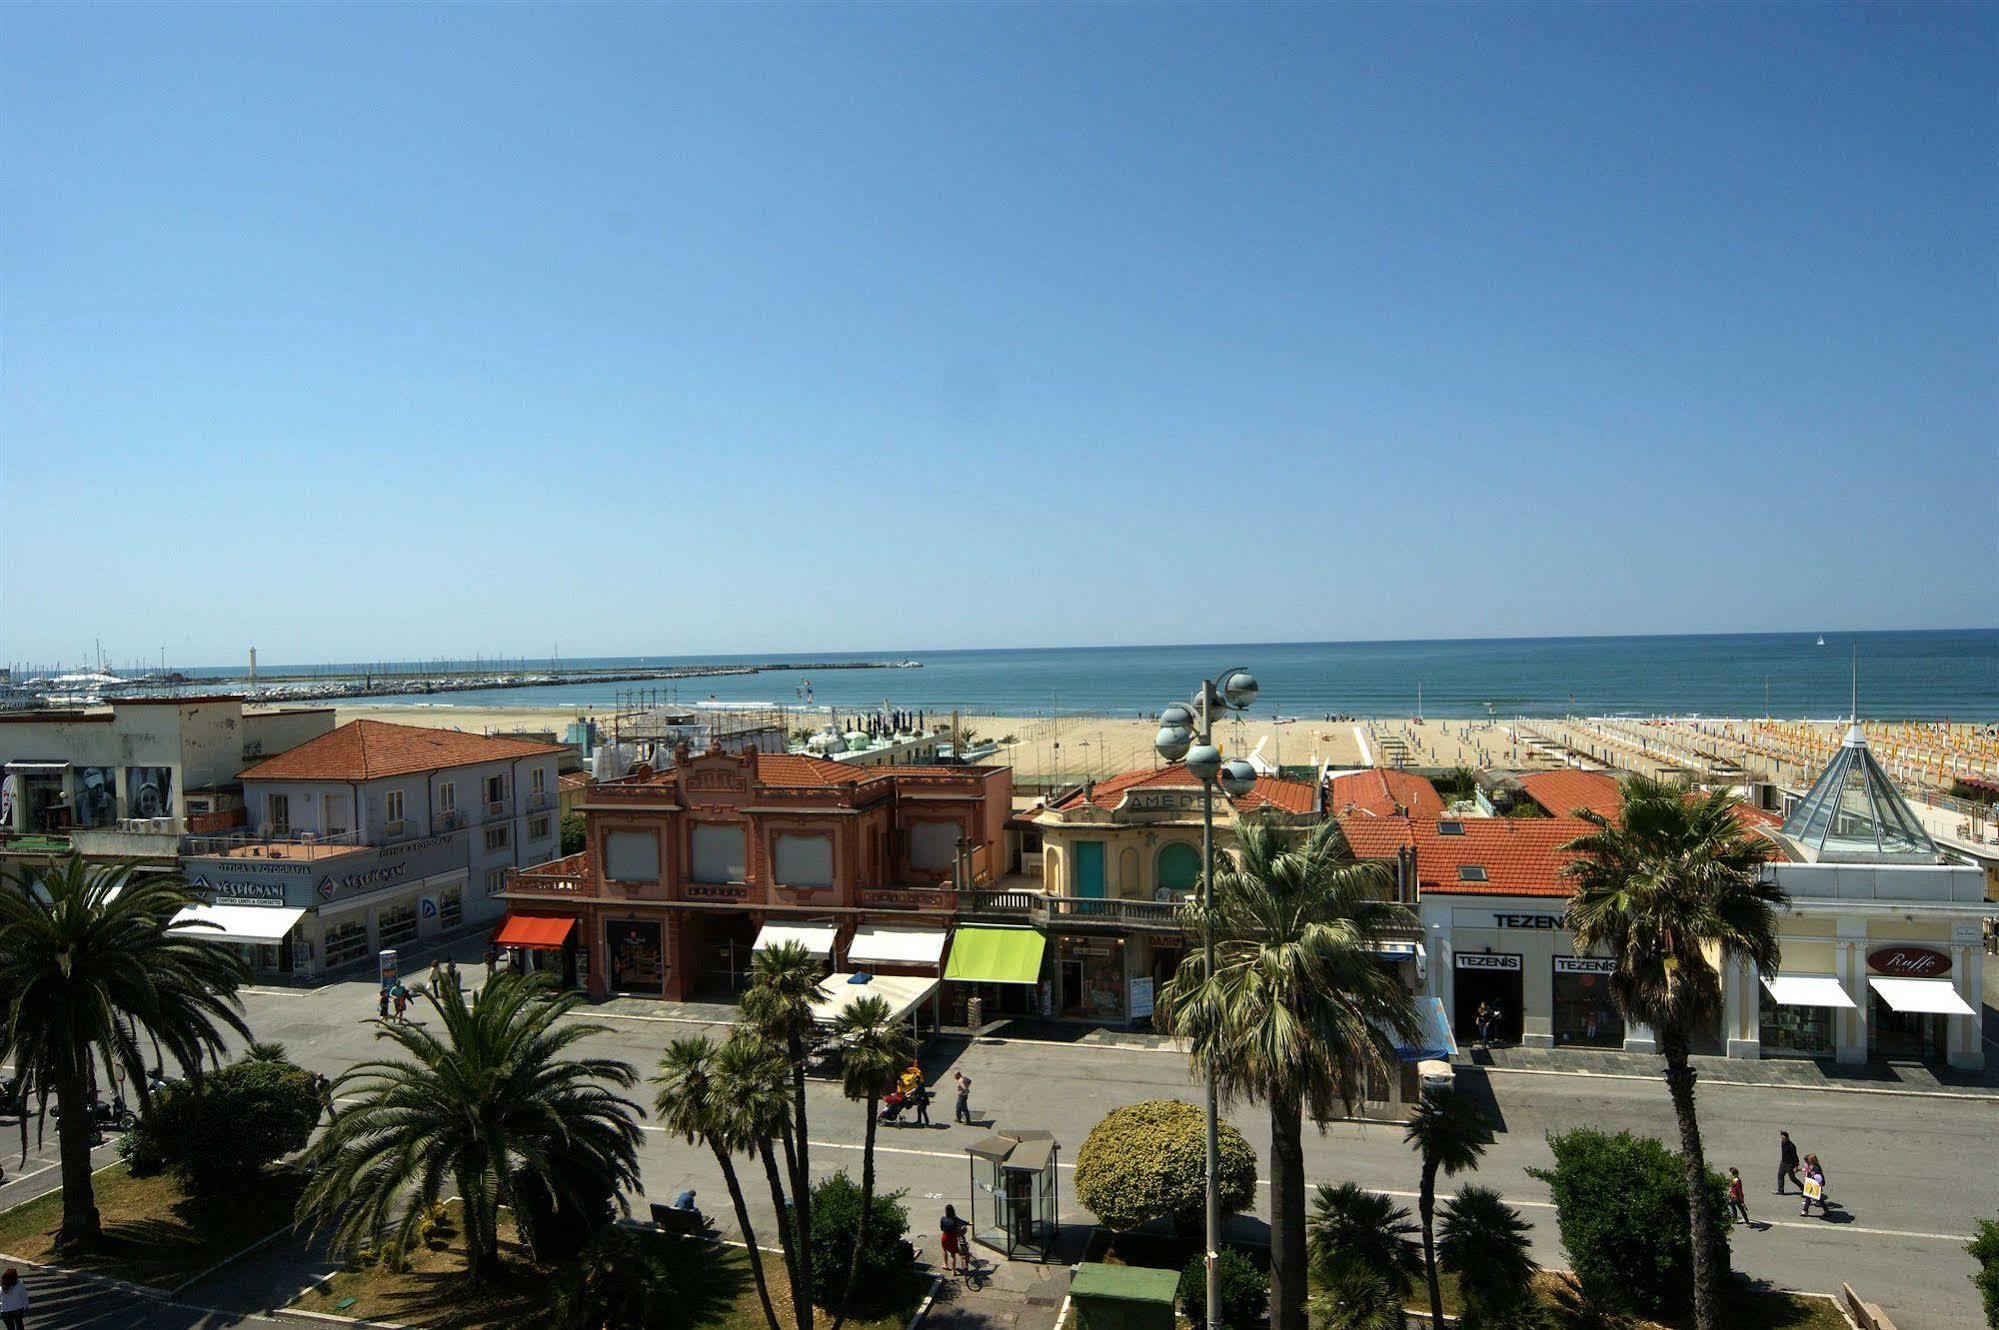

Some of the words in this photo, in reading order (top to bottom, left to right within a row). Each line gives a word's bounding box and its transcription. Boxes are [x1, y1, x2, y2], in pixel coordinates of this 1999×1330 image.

[1131, 794, 1223, 810] AMEDEO
[218, 863, 248, 873] OTTICA
[258, 864, 311, 875] FOTOGRAFIA
[344, 861, 408, 889] VESPIGNANI
[217, 880, 285, 898] VESPIGNANI
[1493, 913, 1565, 929] TEZEN
[1458, 955, 1519, 968] TEZENIS
